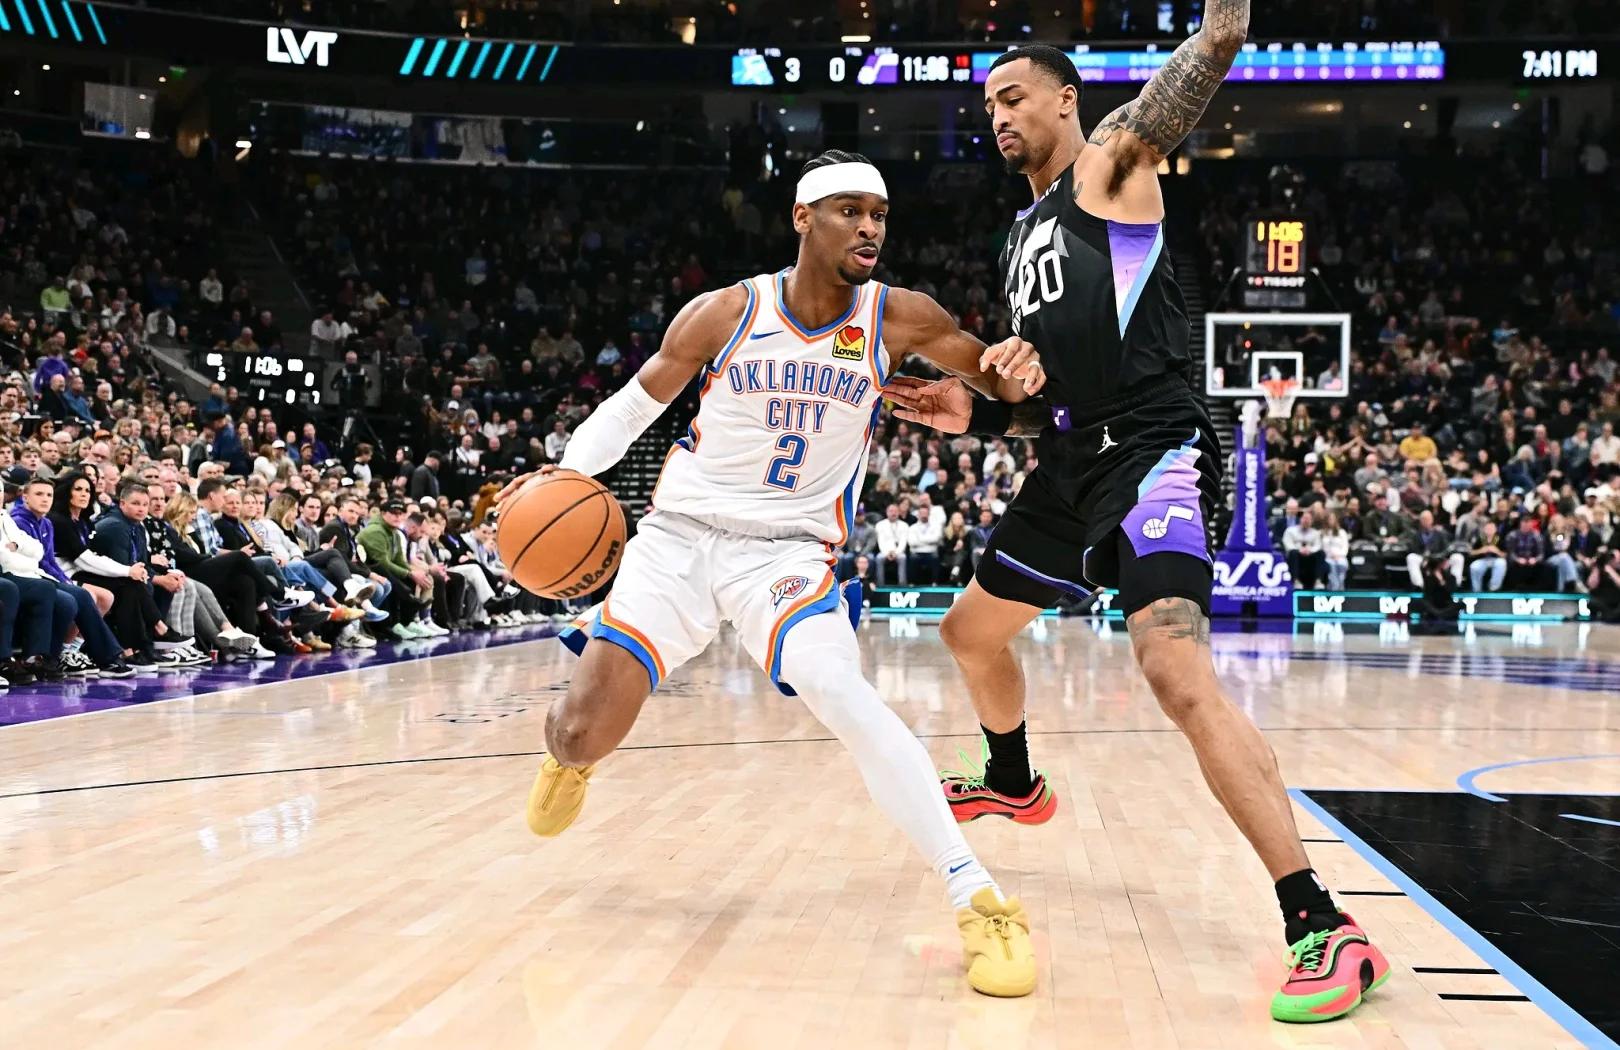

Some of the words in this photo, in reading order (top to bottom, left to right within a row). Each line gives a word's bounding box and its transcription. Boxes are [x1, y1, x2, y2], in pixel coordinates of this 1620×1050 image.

[267, 27, 338, 66] LVT
[785, 57, 801, 82] 3
[829, 57, 845, 82] 0
[1523, 50, 1562, 77] 7:41
[1565, 50, 1597, 77] PM
[1267, 241, 1299, 272] 18
[1021, 249, 1064, 317] 20
[727, 359, 871, 408] OKLAHOMA
[766, 398, 829, 433] CITY
[763, 432, 808, 492] 2
[553, 539, 621, 598] Wilson
[889, 591, 921, 609] LVT
[1313, 595, 1346, 613] LVT
[1379, 596, 1411, 614] LVT
